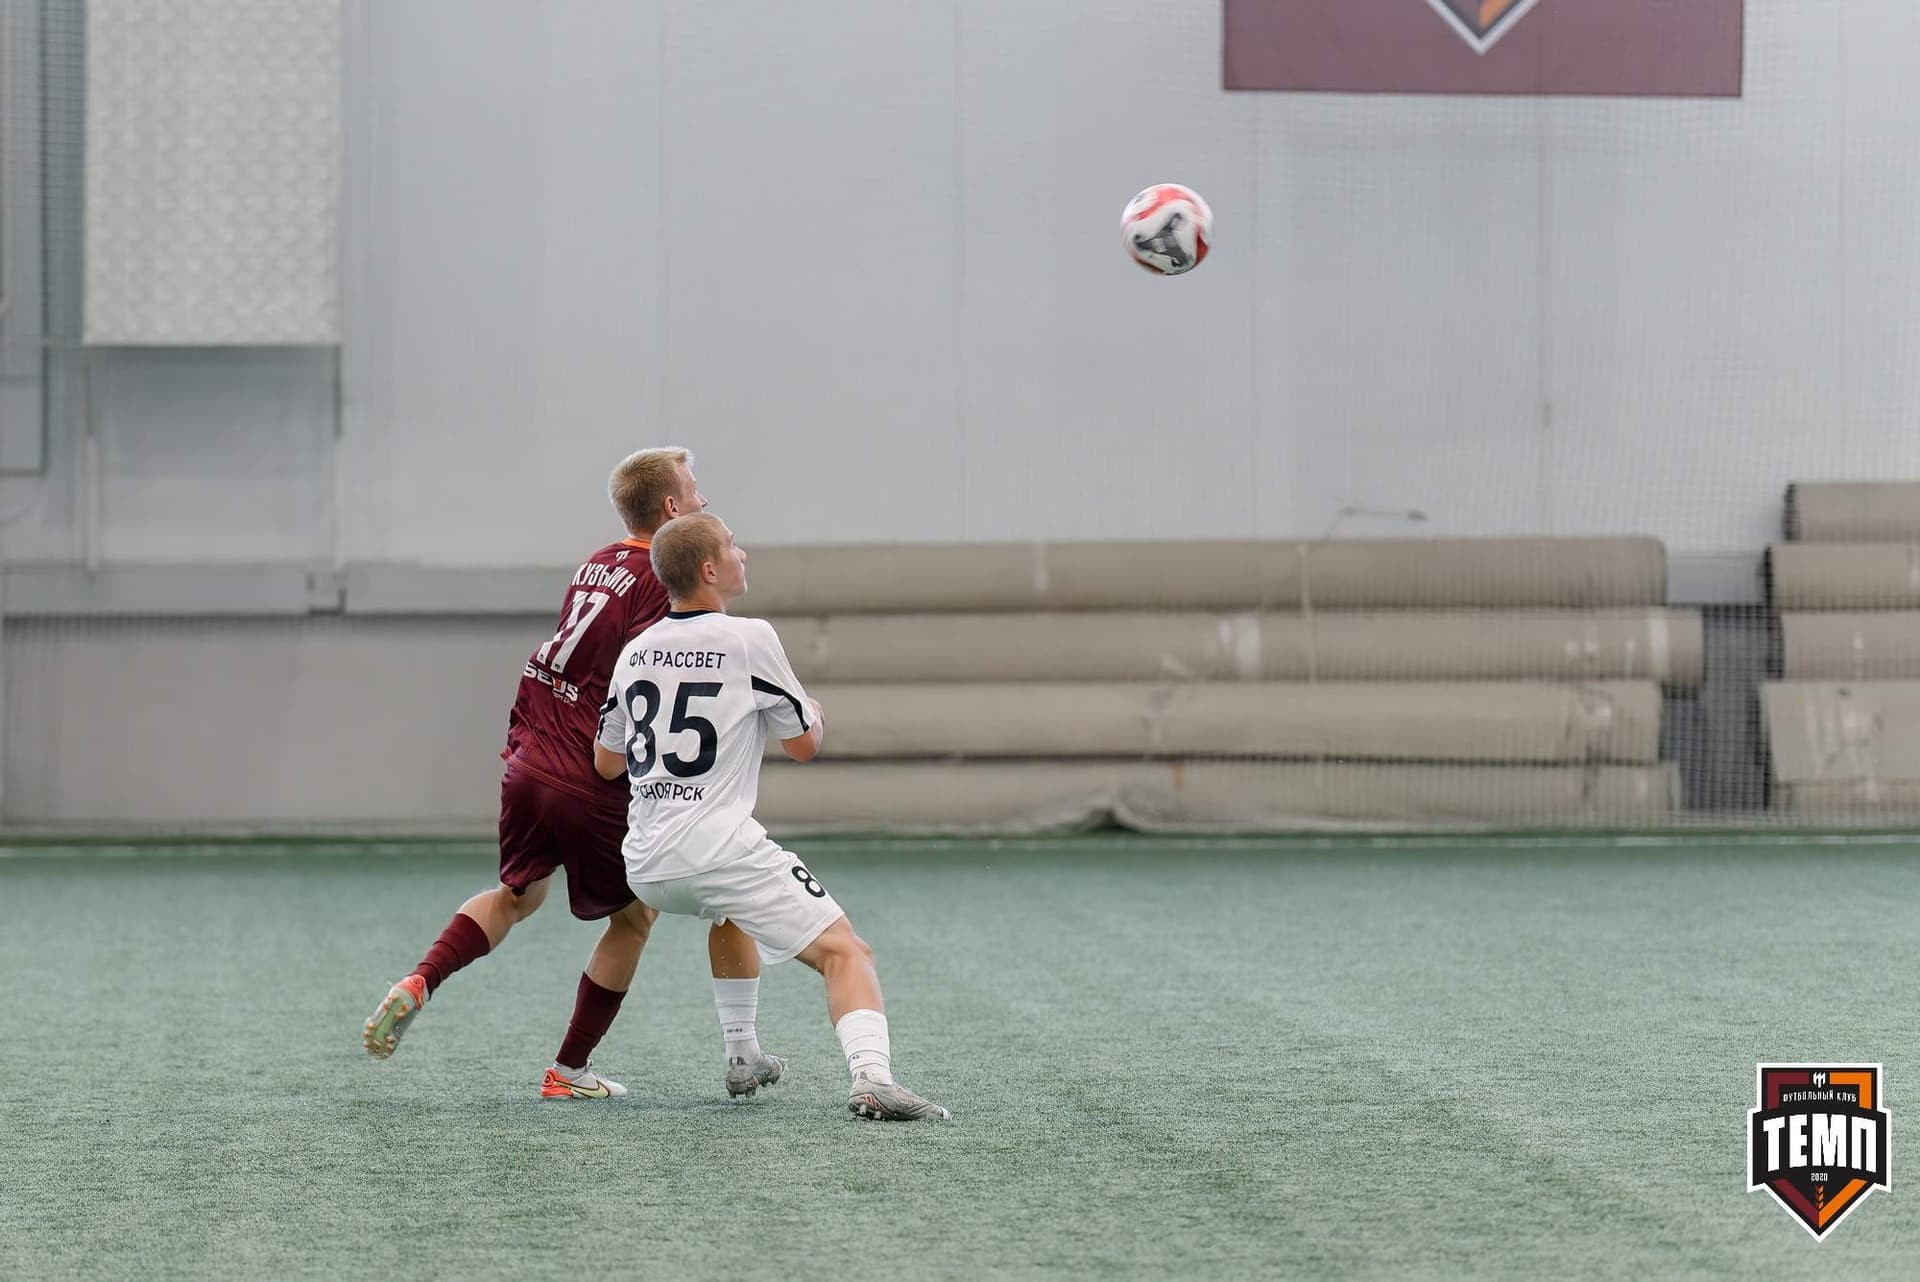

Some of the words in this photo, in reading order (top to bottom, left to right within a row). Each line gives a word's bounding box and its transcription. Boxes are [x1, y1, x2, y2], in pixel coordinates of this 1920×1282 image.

[629, 650, 648, 668] ФК
[652, 650, 727, 669] РАССВЕТ
[625, 679, 724, 778] 85
[791, 865, 826, 898] 8
